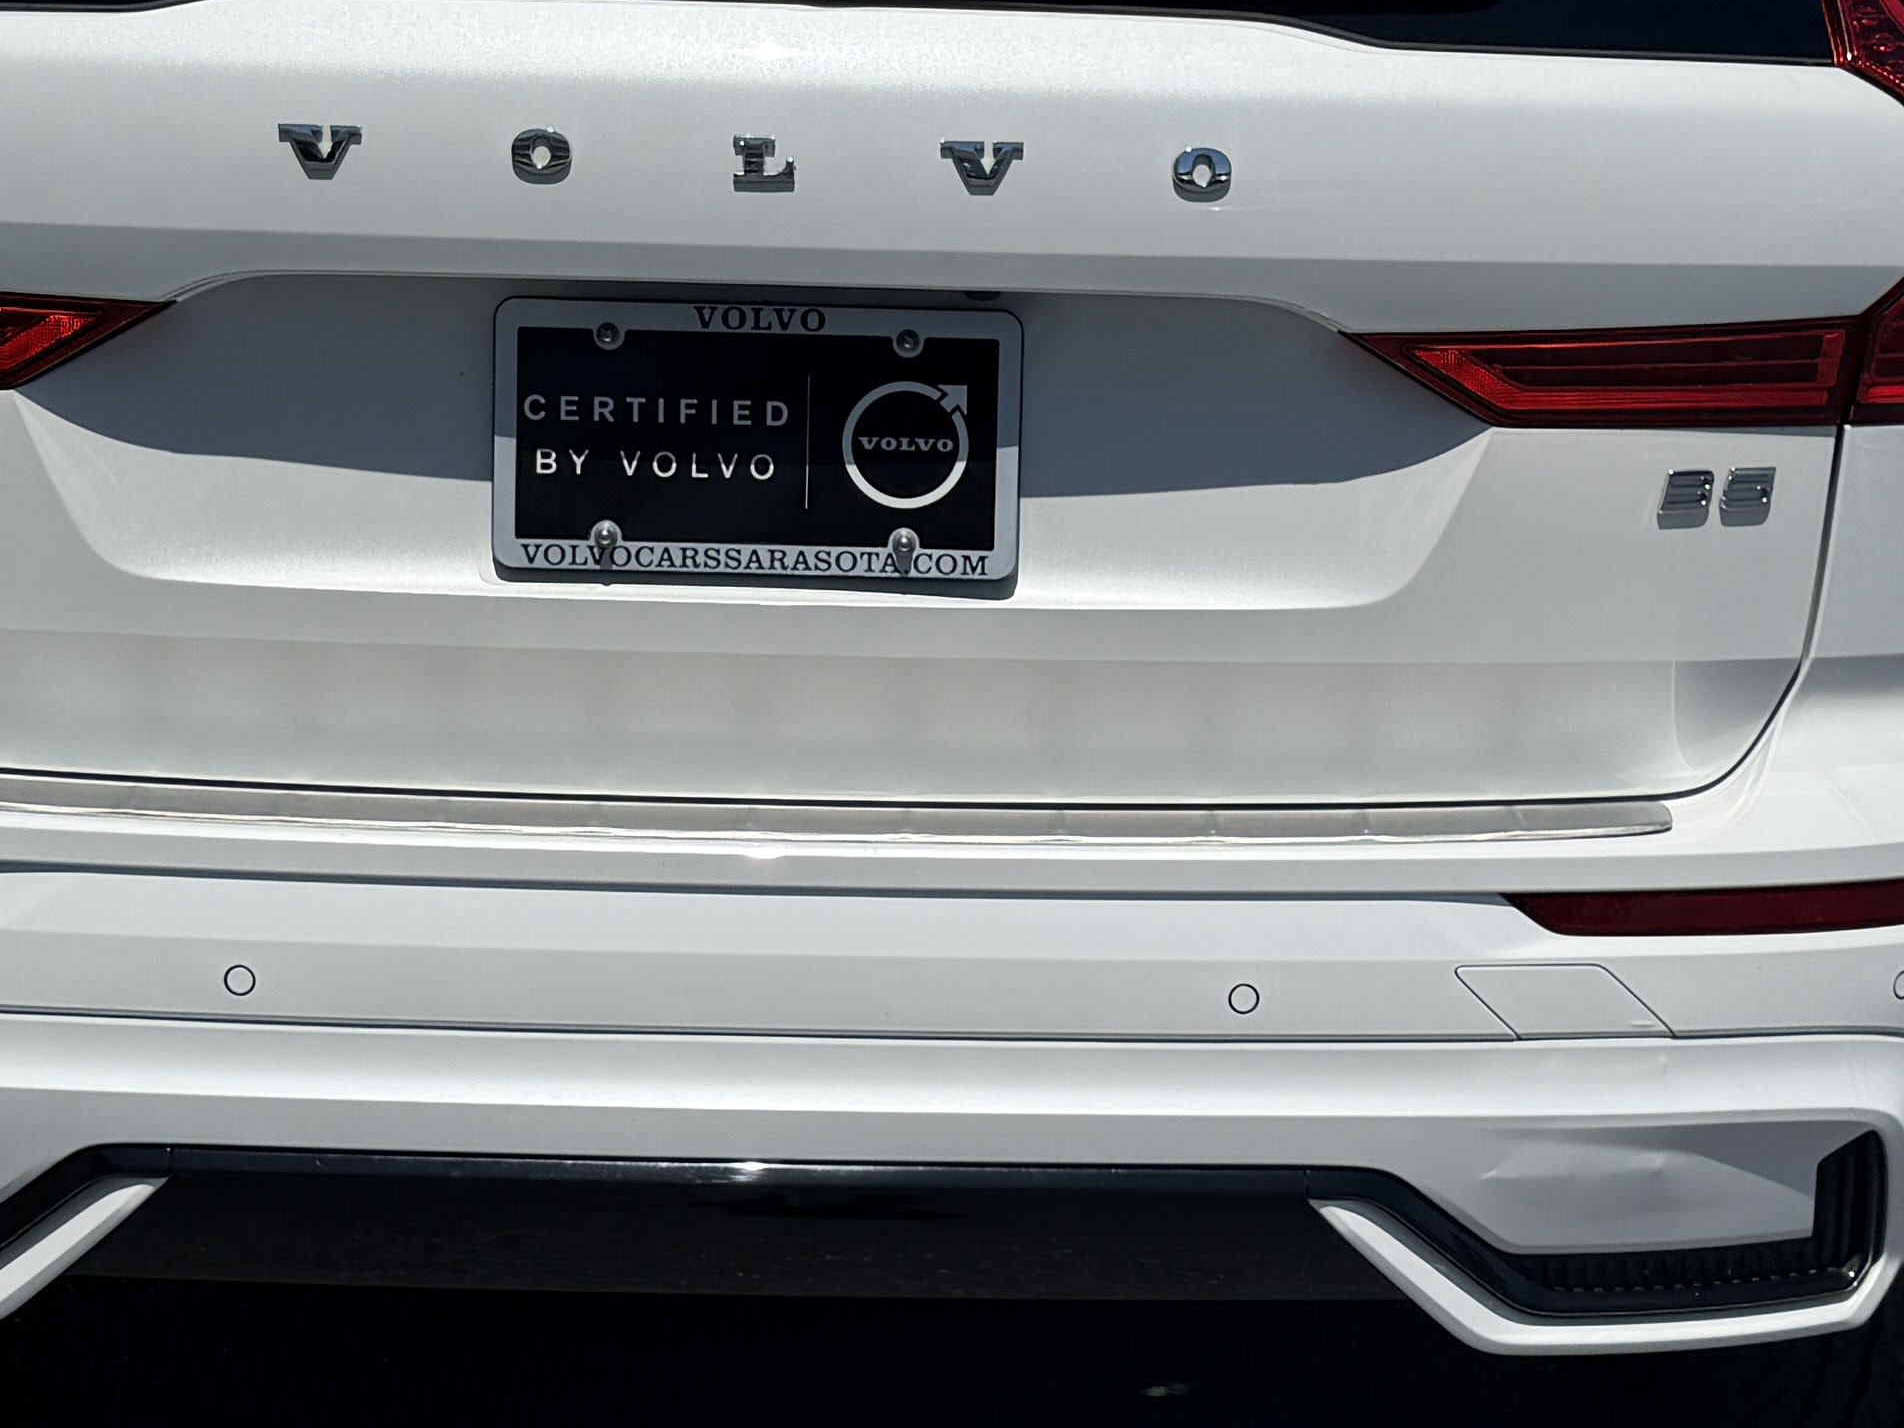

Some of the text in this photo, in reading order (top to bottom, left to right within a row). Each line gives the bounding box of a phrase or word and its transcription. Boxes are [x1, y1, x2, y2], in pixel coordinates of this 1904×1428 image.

[277, 122, 1233, 203] VOLVO
[694, 305, 827, 333] VOLVO
[523, 394, 789, 427] CERTIFIED
[858, 436, 955, 453] VOLVO
[535, 448, 775, 481] BY VOLVO
